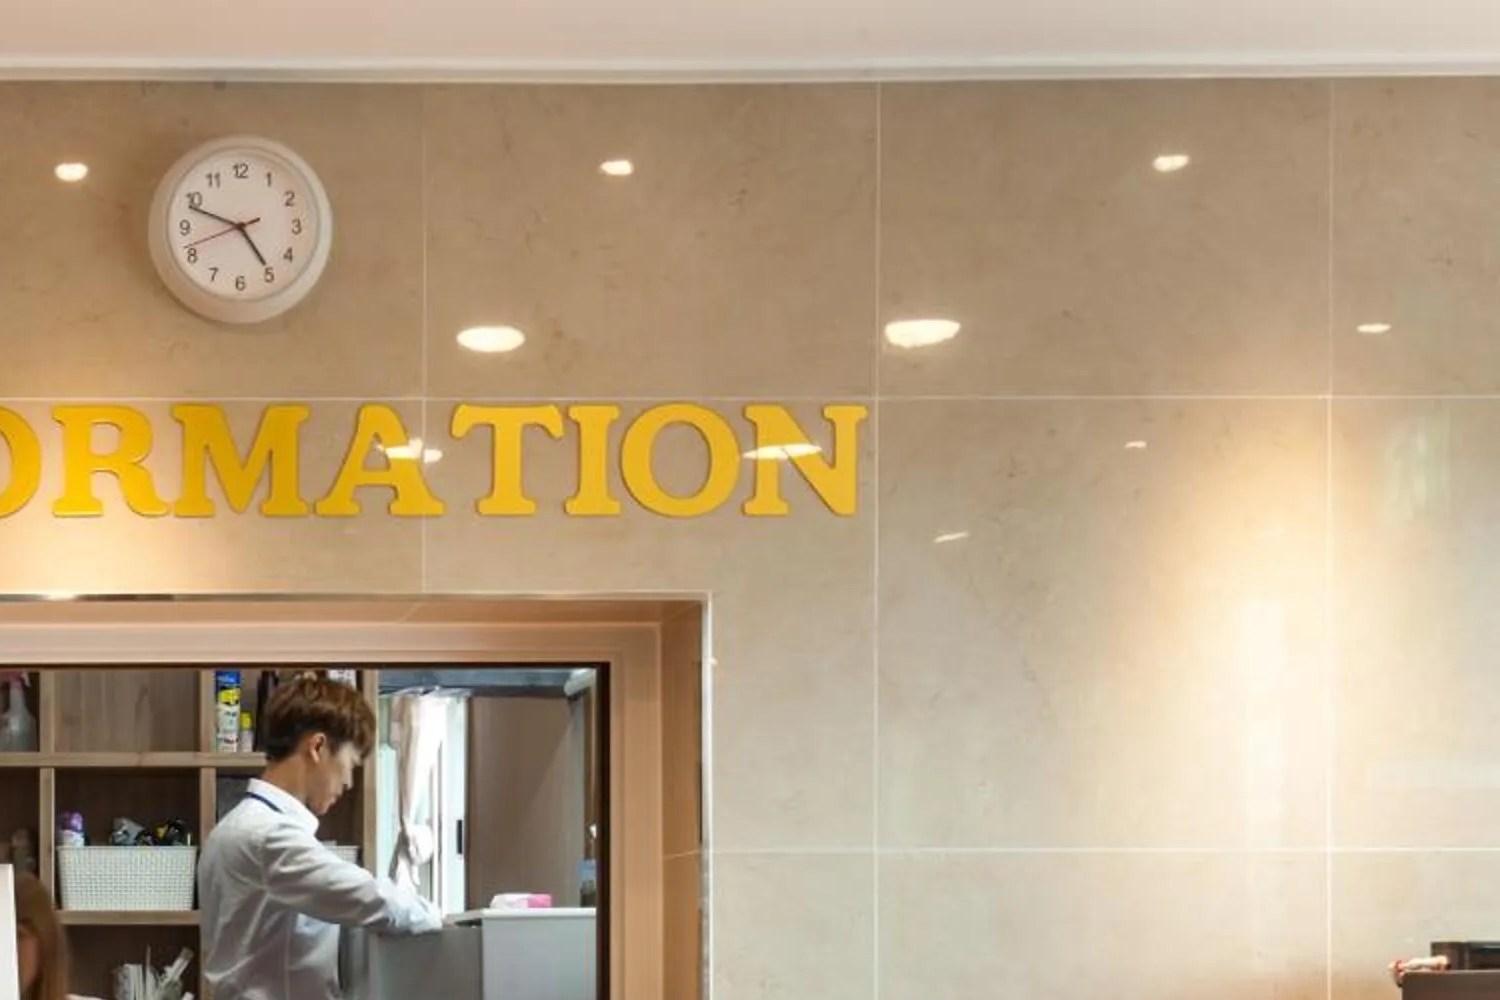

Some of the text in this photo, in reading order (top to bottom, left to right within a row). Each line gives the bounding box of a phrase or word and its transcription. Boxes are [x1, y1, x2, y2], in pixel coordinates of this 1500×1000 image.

[232, 163, 249, 179] 12
[205, 173, 221, 188] 11
[265, 172, 272, 187] 1
[186, 191, 203, 209] 10
[284, 191, 295, 207] 2
[179, 219, 191, 236] 9
[291, 219, 302, 235] 3
[187, 248, 198, 264] 8
[283, 247, 293, 262] 4
[209, 267, 219, 282] 7
[264, 267, 275, 283] 5
[235, 276, 246, 291] 6
